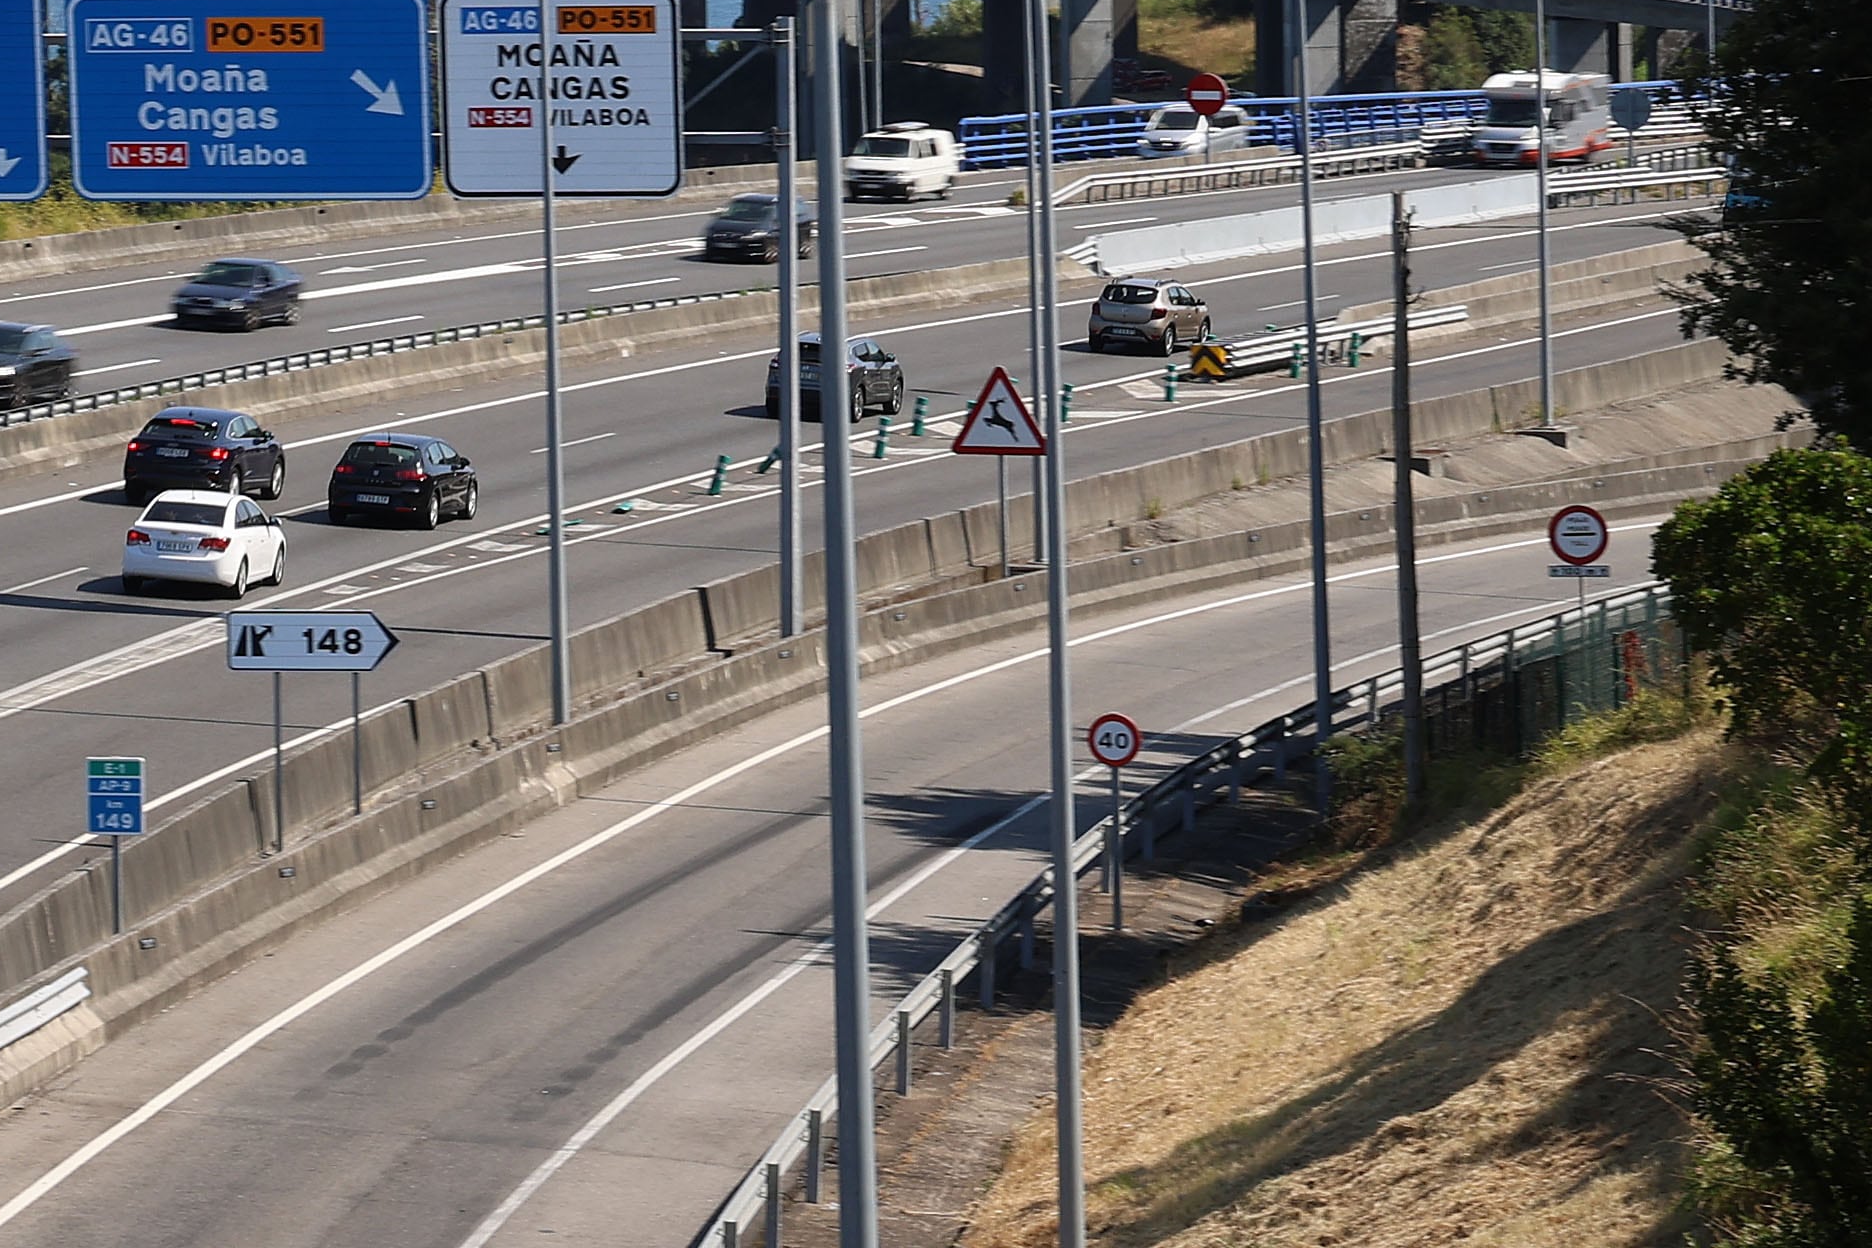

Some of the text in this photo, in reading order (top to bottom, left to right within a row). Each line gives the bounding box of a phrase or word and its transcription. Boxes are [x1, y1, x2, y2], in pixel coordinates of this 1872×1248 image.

[464, 9, 653, 31] AG-46 PO-551
[92, 22, 320, 47] AG-46 PO-551
[497, 39, 620, 68] MOAÑA
[144, 63, 269, 93] Moaña
[490, 75, 630, 101] CANGAS
[138, 101, 278, 139] Cangas
[470, 109, 530, 126] N-554
[112, 143, 307, 166] N-554 Vilaboa
[302, 628, 363, 655] 148
[1099, 732, 1129, 749] 40
[98, 780, 131, 791] AP-9
[96, 812, 134, 829] 149
